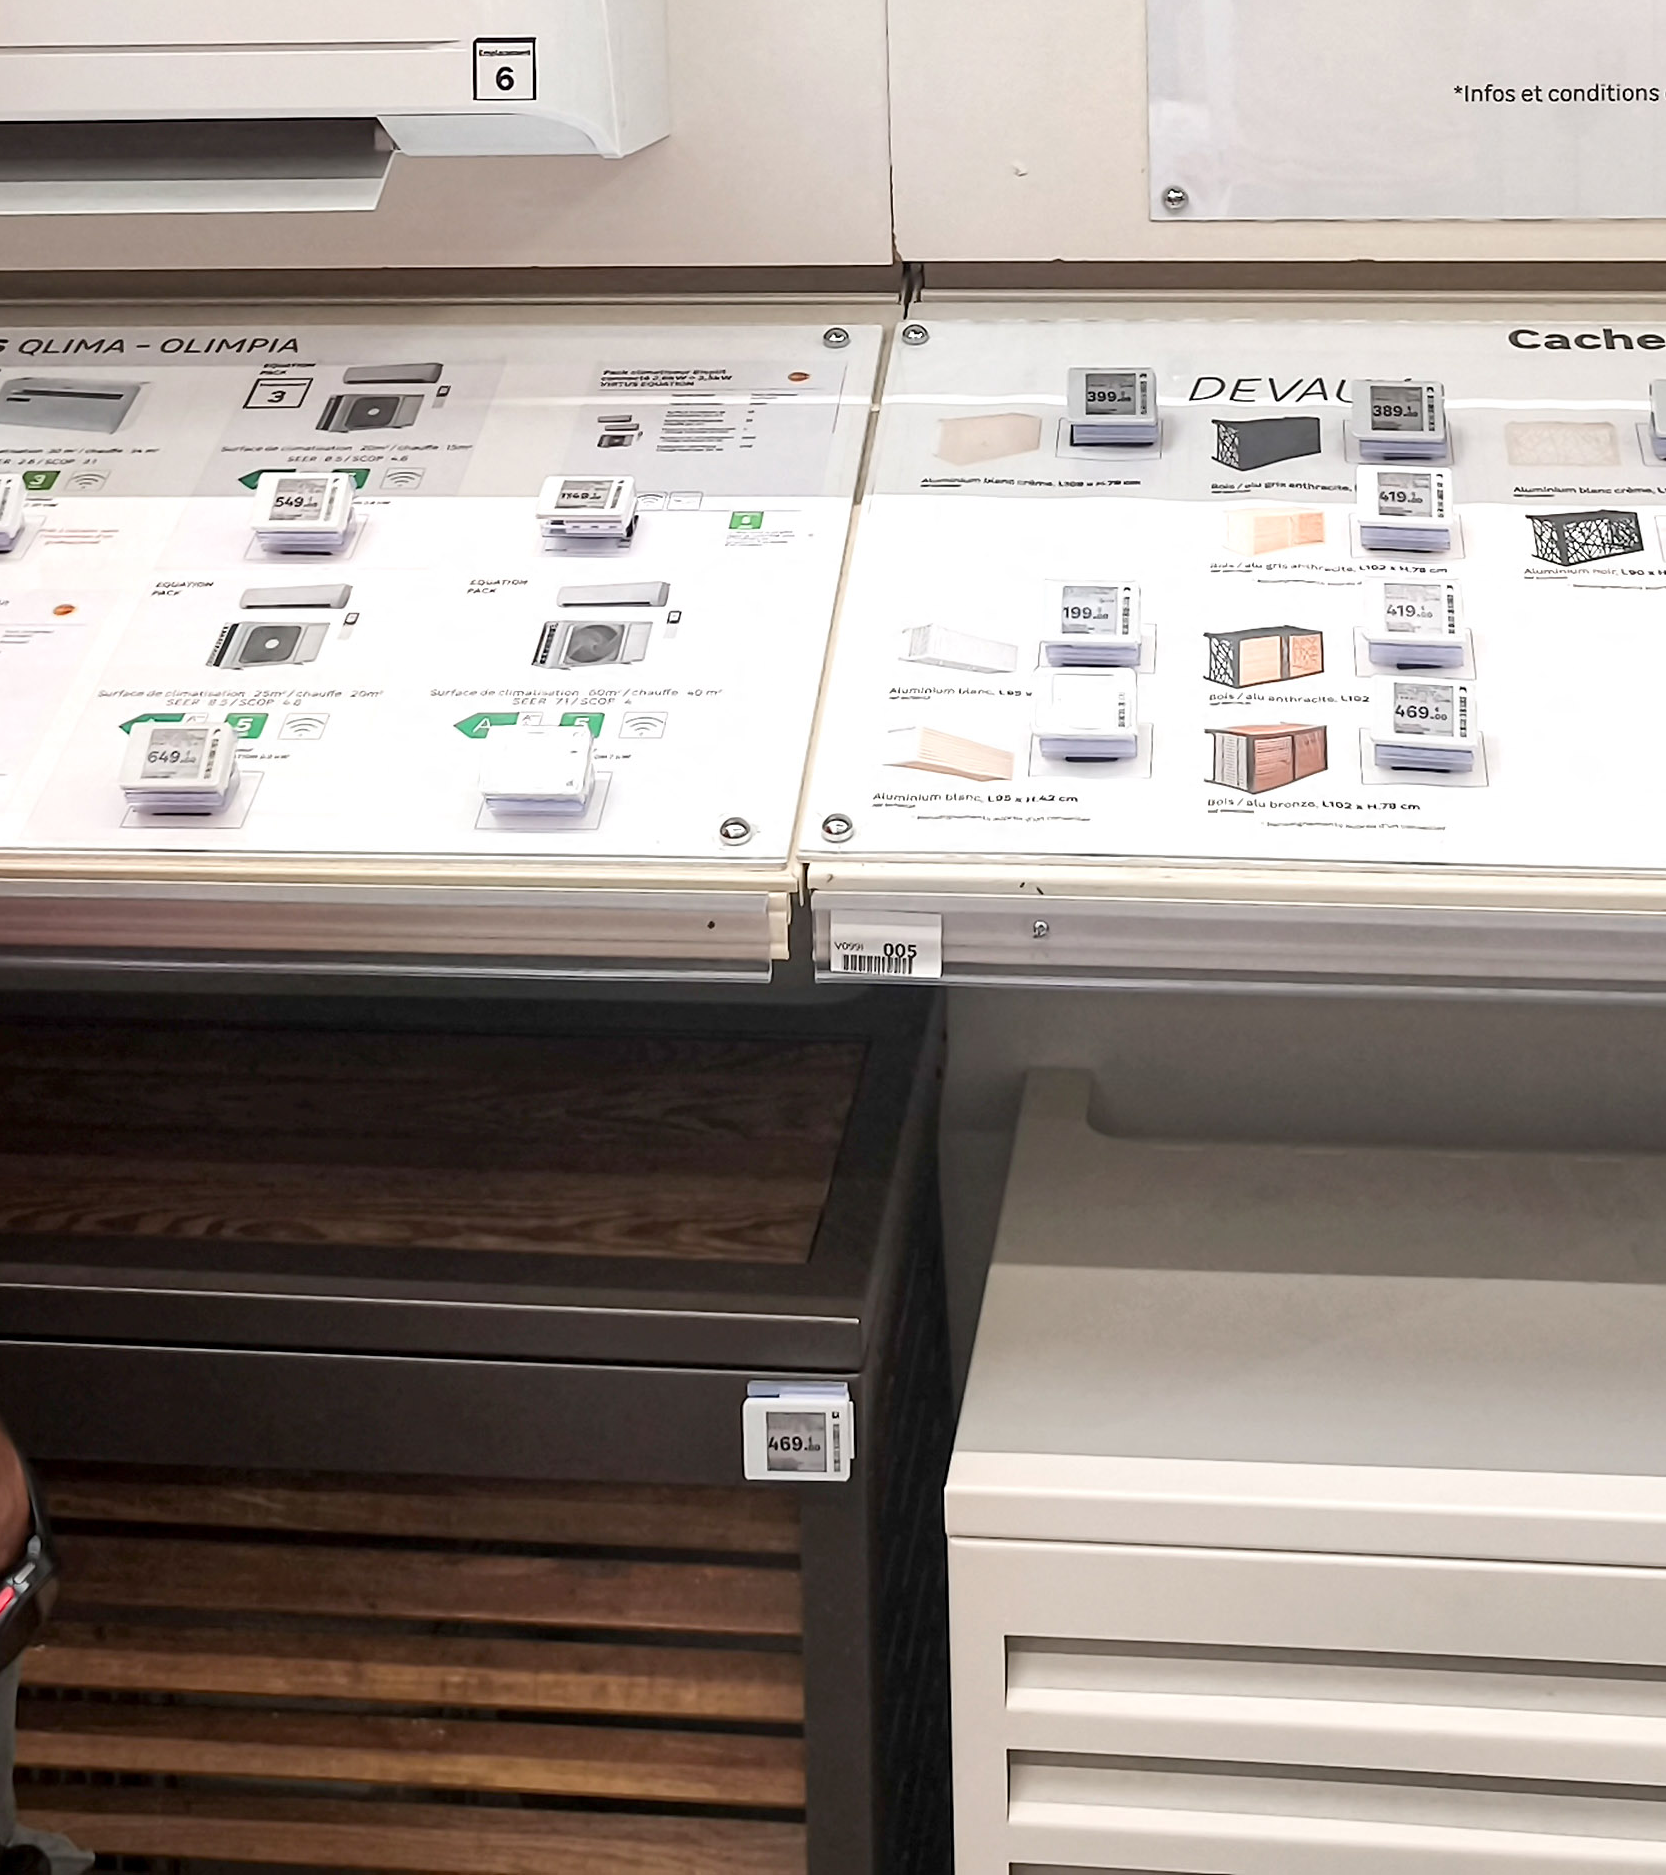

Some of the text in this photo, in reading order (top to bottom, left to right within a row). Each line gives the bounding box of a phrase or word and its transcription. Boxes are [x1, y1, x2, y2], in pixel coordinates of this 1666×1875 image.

[496, 66, 514, 91] 6
[1521, 86, 1543, 102] et
[1547, 83, 1660, 102] conditions
[18, 338, 125, 356] QLIMA
[160, 338, 299, 354] OLIMPIA
[883, 943, 917, 958] 005
